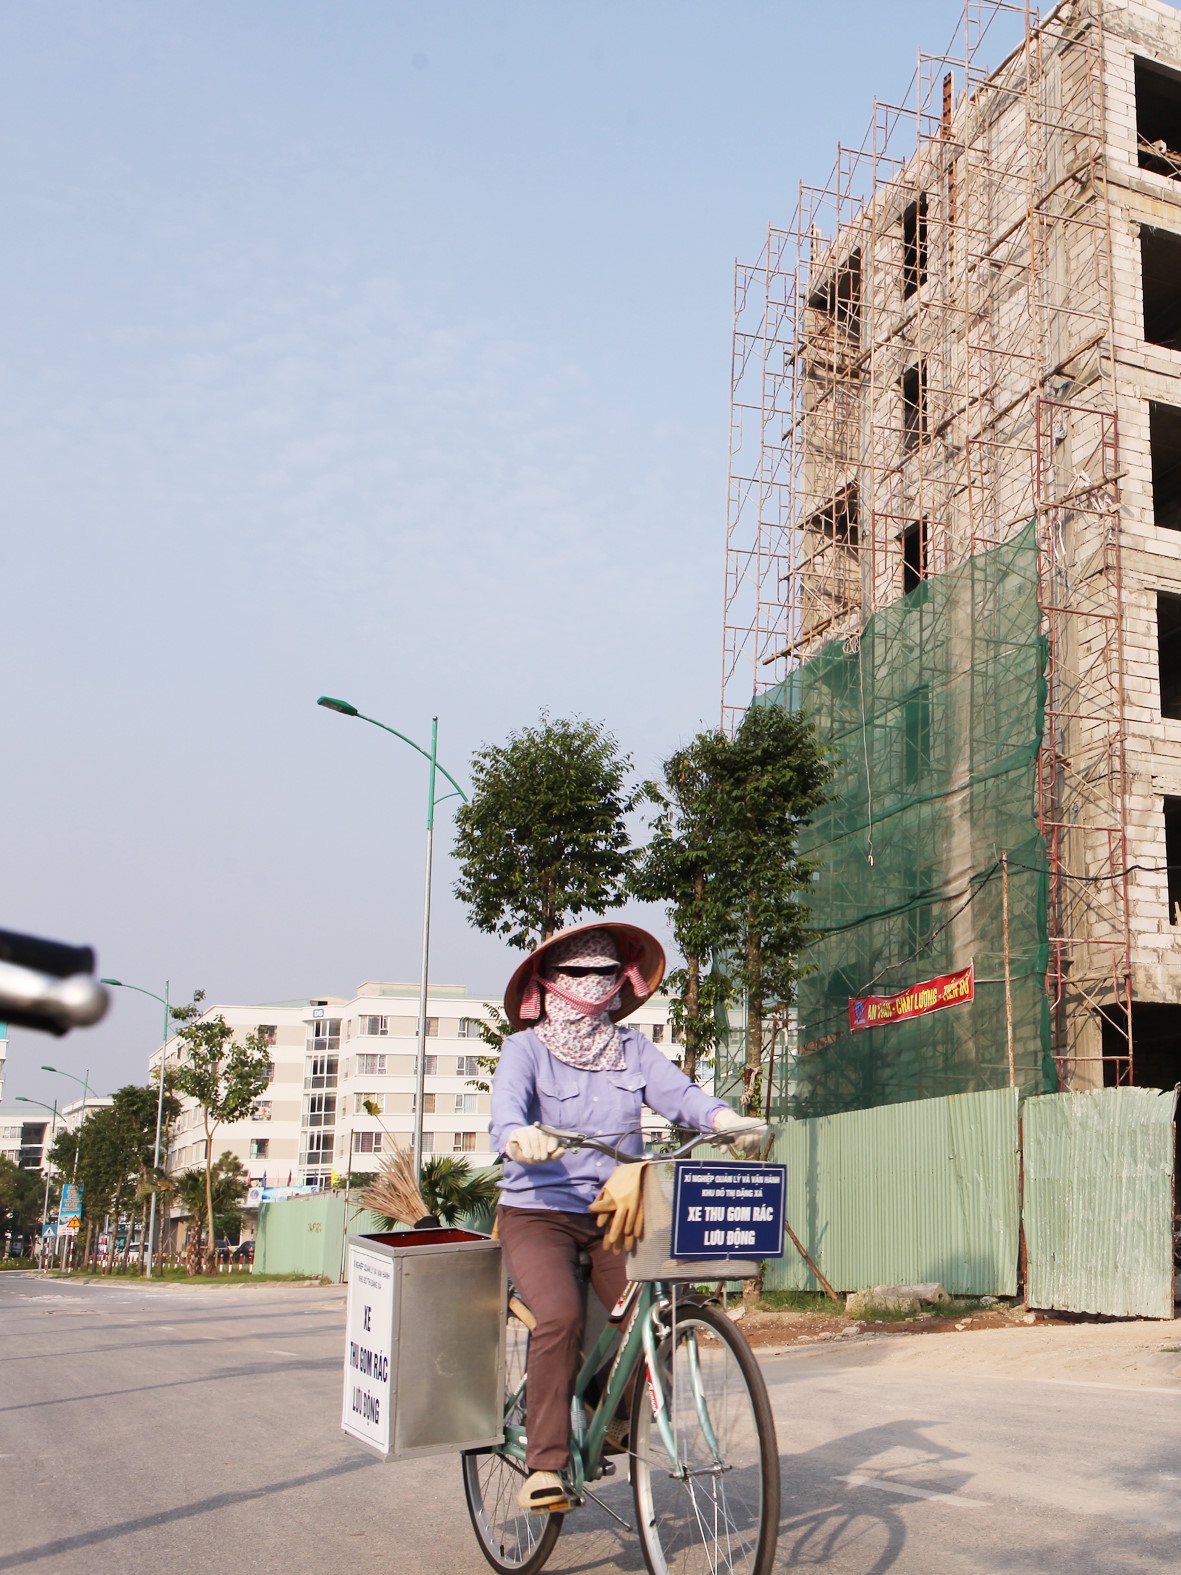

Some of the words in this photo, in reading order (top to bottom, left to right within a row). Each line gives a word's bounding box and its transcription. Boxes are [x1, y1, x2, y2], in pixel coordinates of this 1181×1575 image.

[684, 1173, 691, 1182] XÍ
[692, 1173, 714, 1184] NGHIỆP
[715, 1173, 732, 1183] QUẢN
[733, 1174, 741, 1183] LÝ
[742, 1174, 750, 1183] VÀ
[751, 1174, 763, 1185] VẬN
[764, 1174, 780, 1183] HÀNH
[687, 1207, 702, 1221] XE
[704, 1207, 725, 1221] THU
[727, 1207, 751, 1221] GOM
[752, 1204, 773, 1221] RÁC
[704, 1229, 725, 1246] LƯU
[726, 1228, 755, 1248] ĐỘNG
[364, 1305, 371, 1332] XE
[350, 1341, 359, 1369] THU
[360, 1347, 372, 1376] GOM
[374, 1350, 388, 1382] RÁC
[363, 1389, 379, 1425] ĐỘNG
